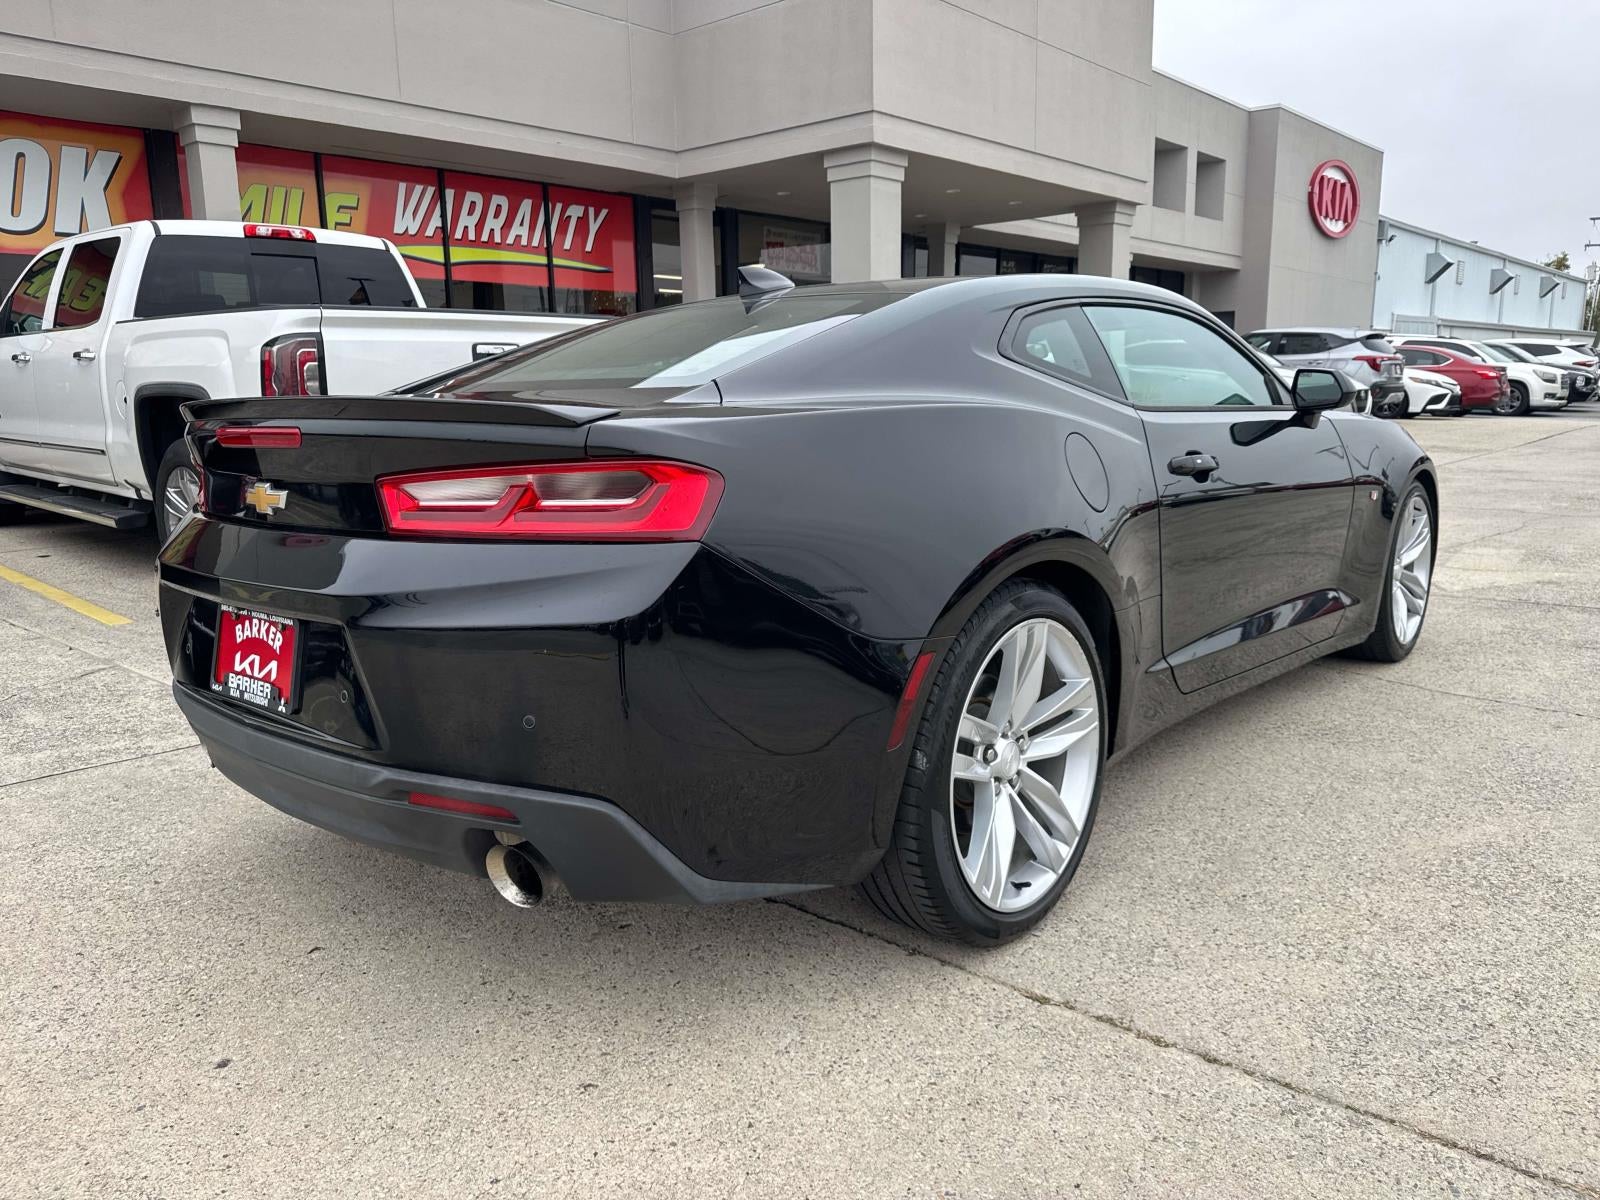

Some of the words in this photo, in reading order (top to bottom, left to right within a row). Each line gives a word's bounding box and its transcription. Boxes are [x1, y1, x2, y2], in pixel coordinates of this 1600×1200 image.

[393, 182, 609, 252] WARRANTY
[1320, 174, 1352, 223] KIA
[235, 618, 283, 655] BARKER
[230, 687, 240, 698] KIA
[243, 692, 269, 707] MITSUBISHI
